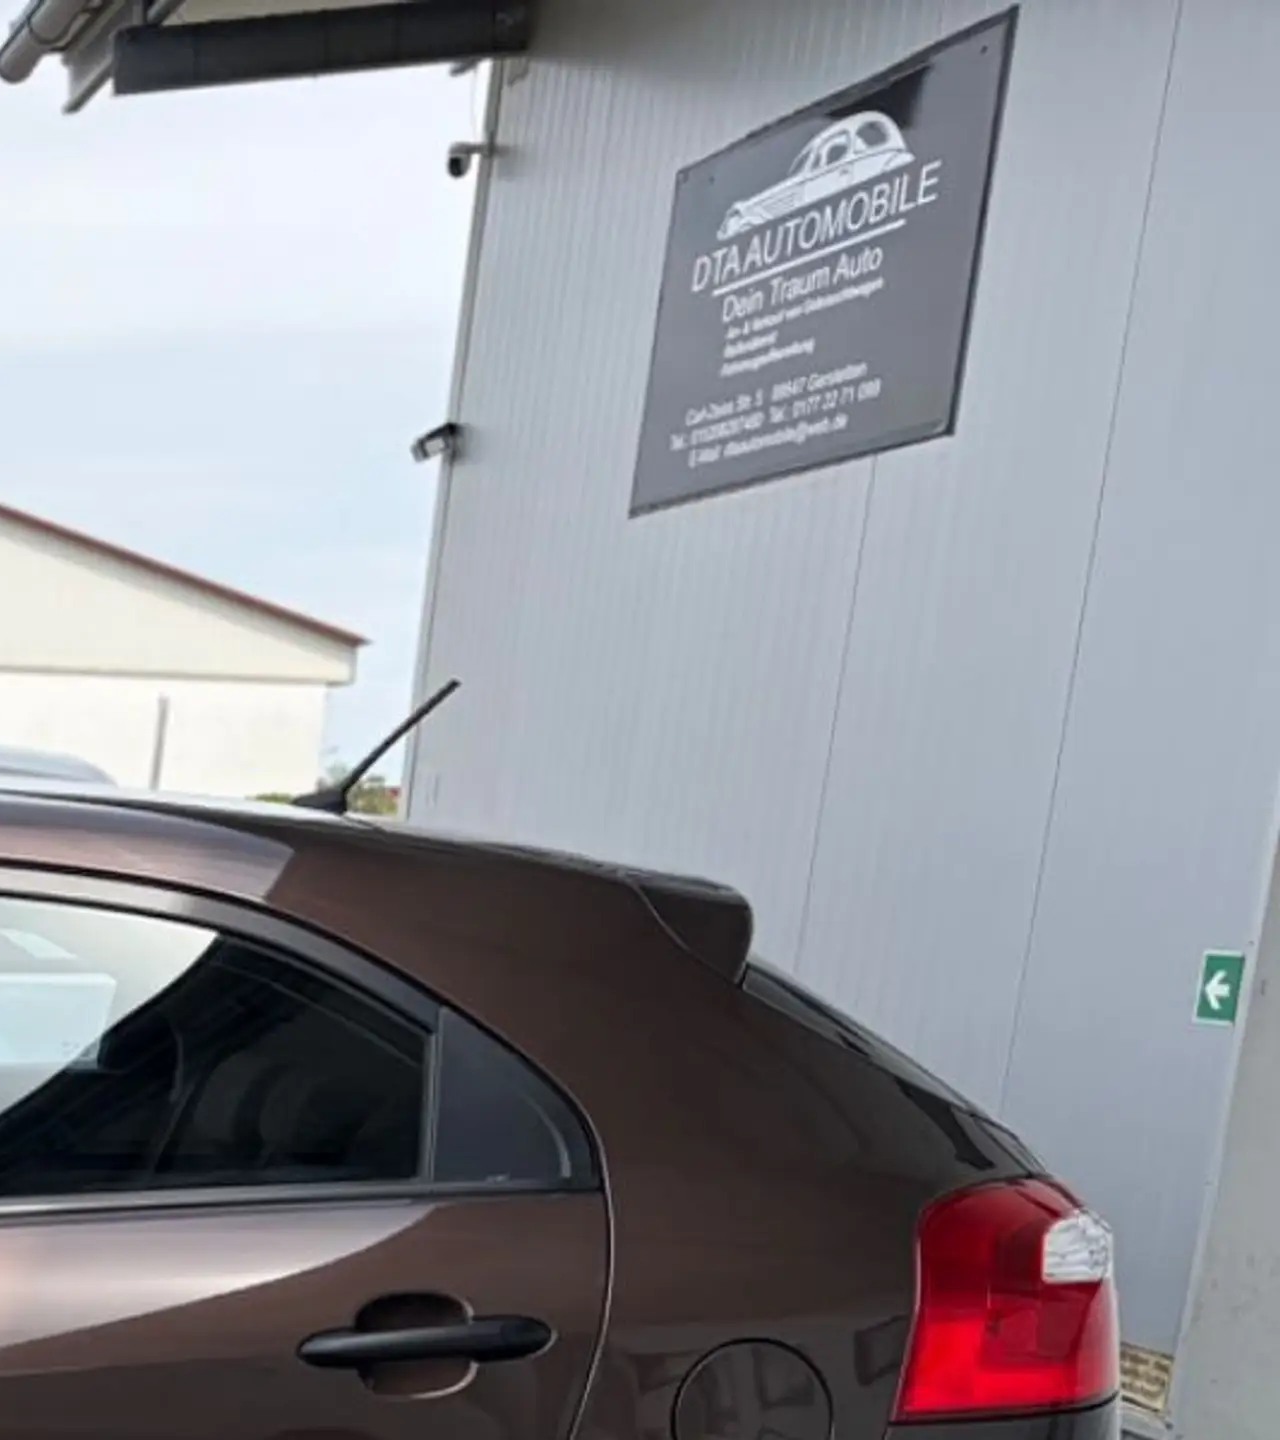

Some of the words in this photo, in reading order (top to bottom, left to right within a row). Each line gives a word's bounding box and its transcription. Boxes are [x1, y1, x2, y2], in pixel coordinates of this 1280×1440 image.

[690, 244, 740, 293] DTA
[742, 159, 942, 273] AUTOMOBILE
[722, 288, 764, 323] Dein
[770, 265, 830, 306] Traum
[832, 246, 884, 285] Auto
